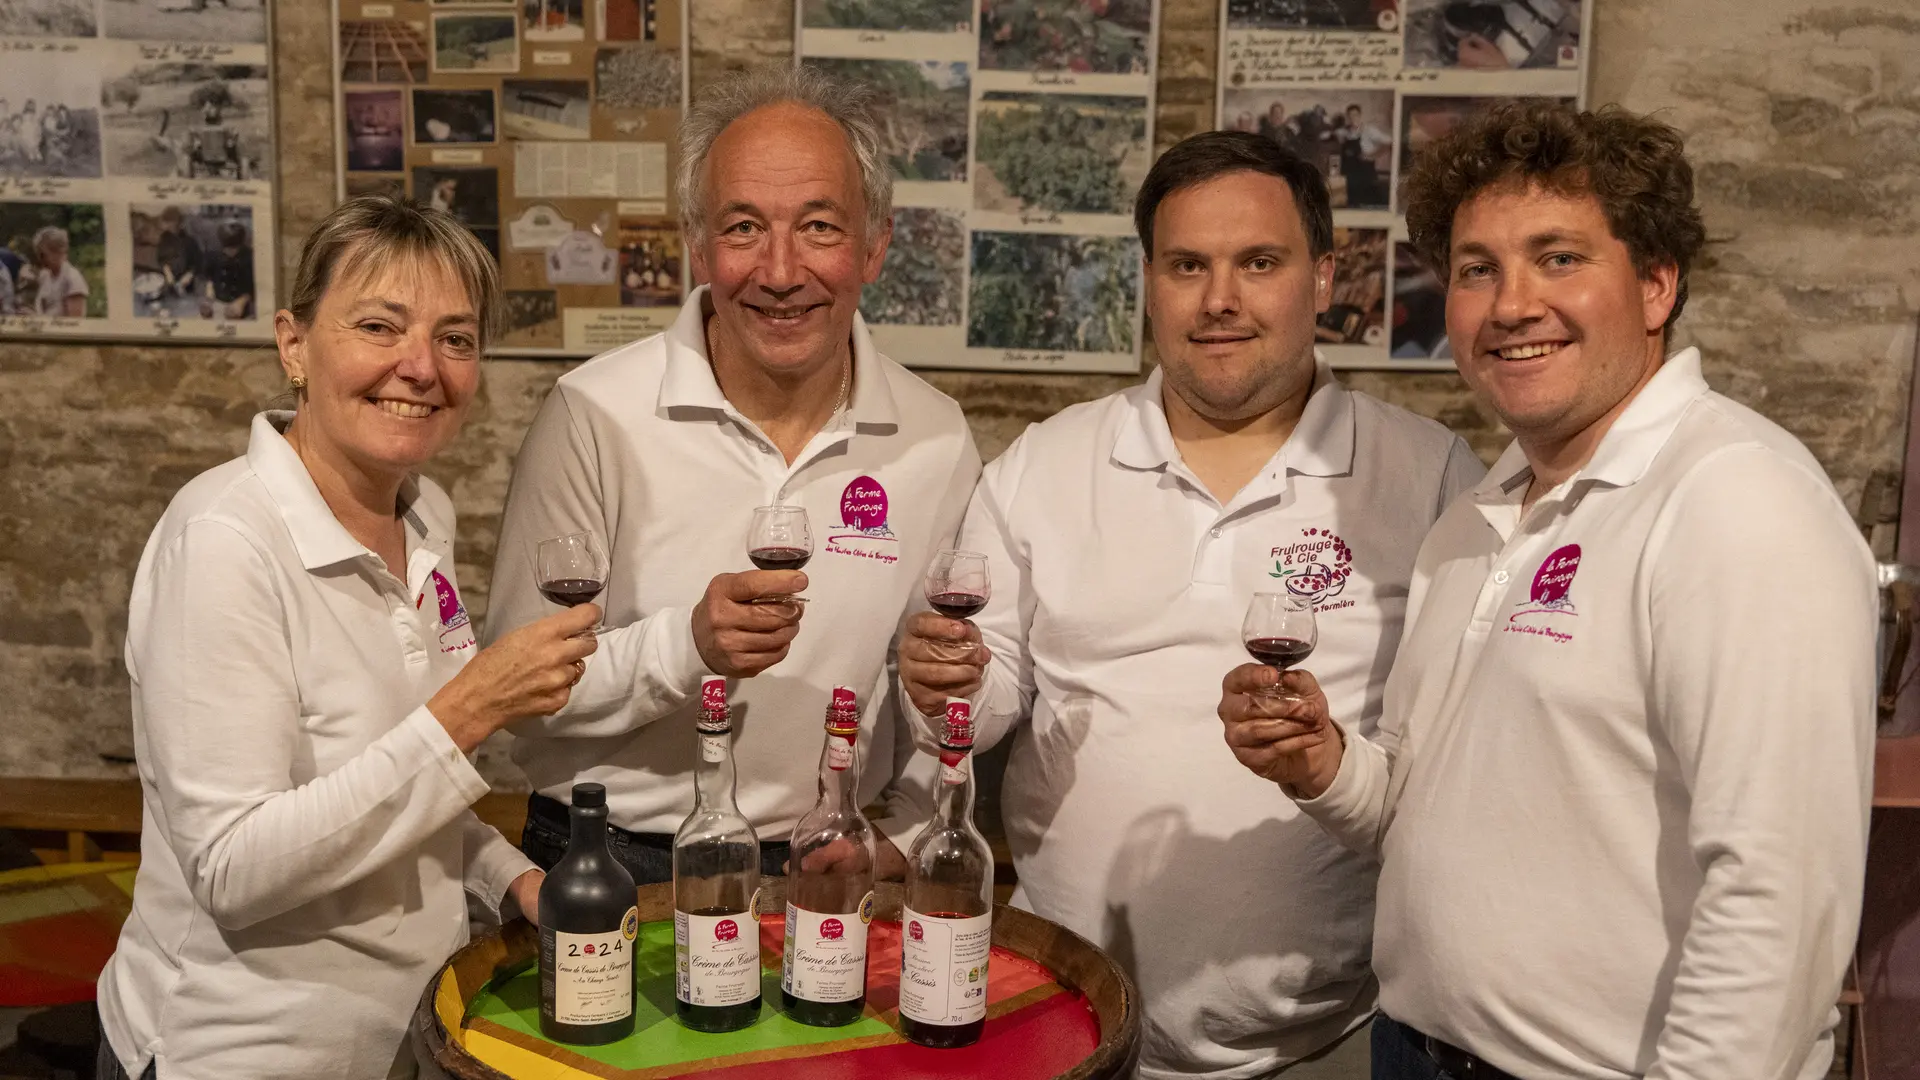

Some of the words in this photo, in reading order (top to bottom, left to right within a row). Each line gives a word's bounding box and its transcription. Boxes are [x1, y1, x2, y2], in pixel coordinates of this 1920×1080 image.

[855, 486, 881, 499] Ferme
[844, 501, 883, 517] Fruirouge
[1271, 540, 1332, 558] Fruirouge
[1284, 555, 1293, 566] &
[1297, 552, 1318, 564] Cie
[691, 955, 721, 969] Crème
[723, 956, 735, 968] de
[795, 948, 824, 965] Crème
[824, 955, 838, 966] de
[910, 970, 937, 988] Cassis
